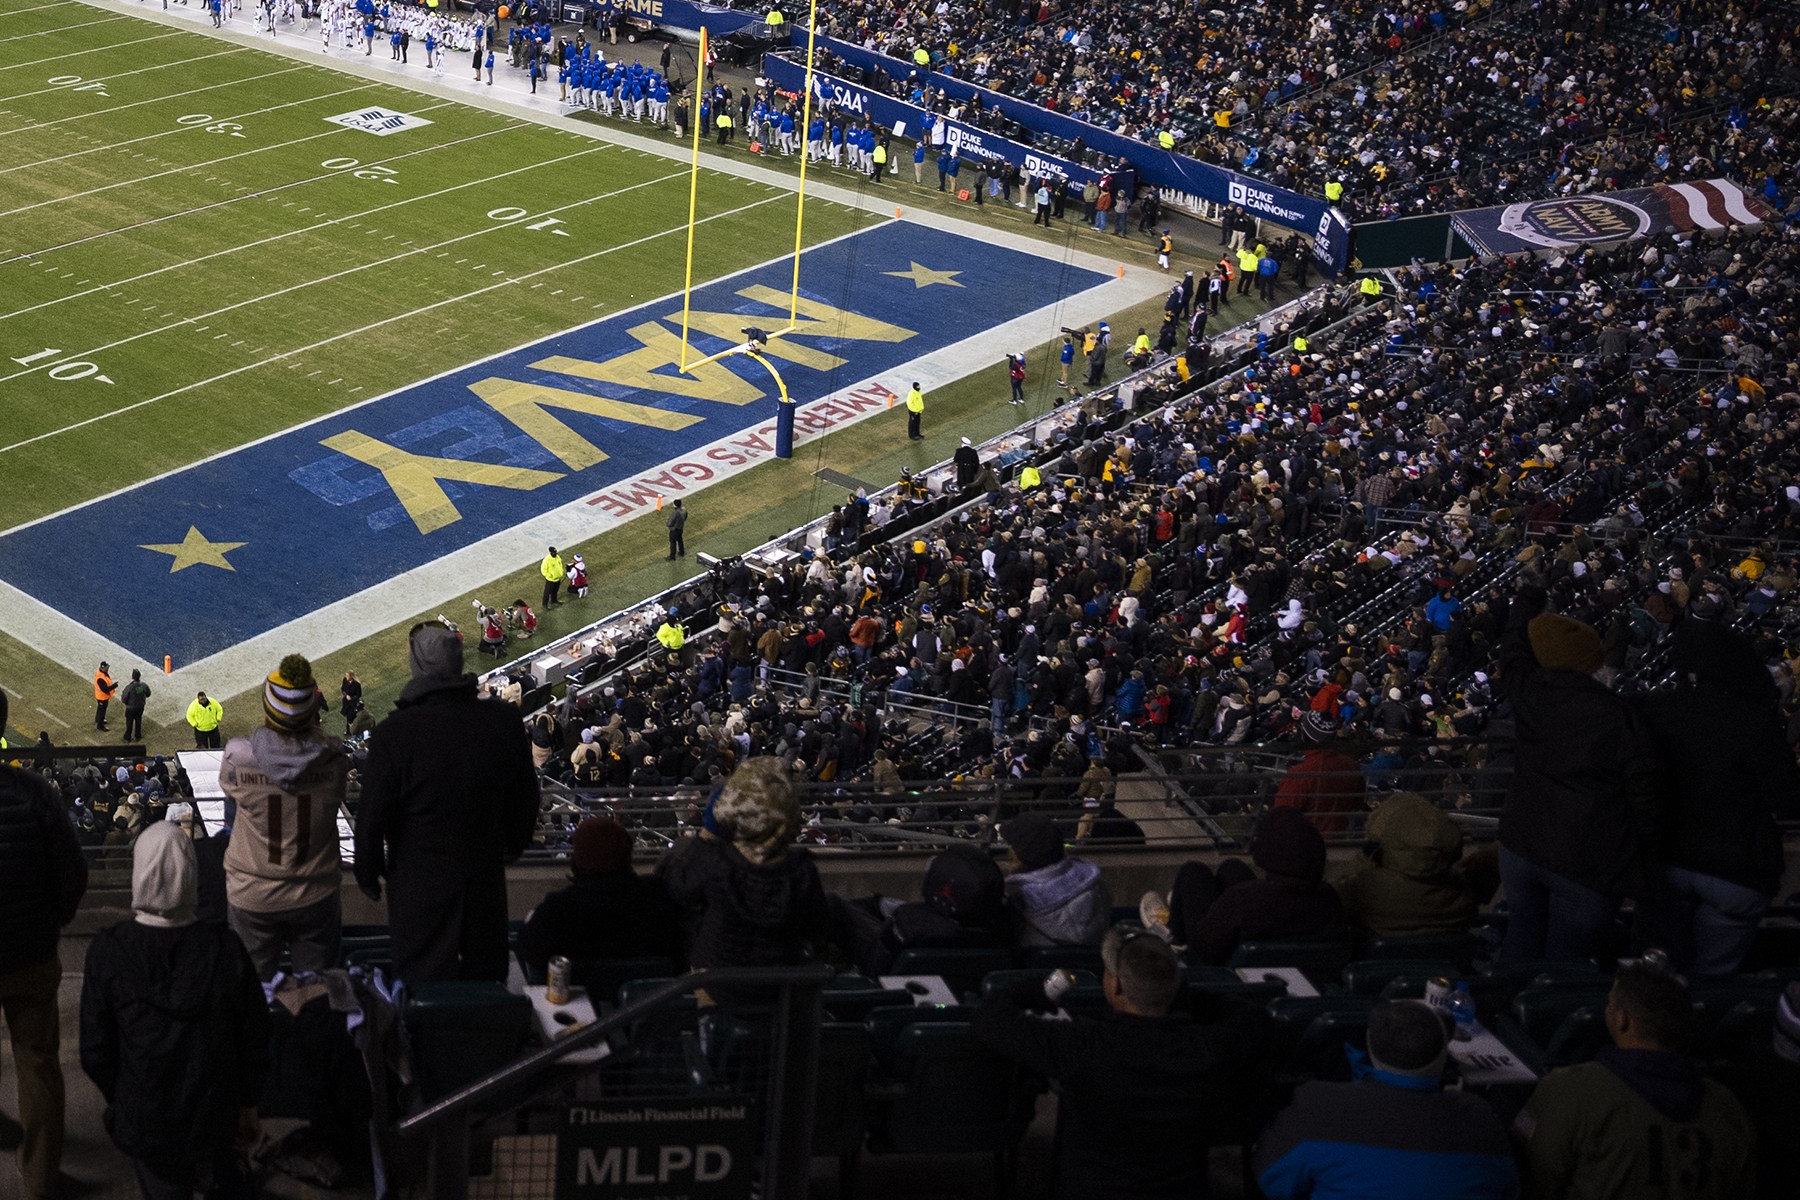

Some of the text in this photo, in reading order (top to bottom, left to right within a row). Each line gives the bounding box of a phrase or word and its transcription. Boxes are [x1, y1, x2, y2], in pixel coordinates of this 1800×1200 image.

[48, 75, 102, 93] 40
[831, 85, 862, 114] SAA
[177, 113, 240, 136] 30
[960, 141, 992, 158] CANNON
[961, 132, 982, 146] DUKE
[320, 156, 398, 182] 20
[1040, 160, 1063, 174] DUKE
[1246, 198, 1288, 219] CANNON
[1248, 188, 1274, 204] DUKE
[487, 206, 564, 233] 10
[1532, 208, 1586, 236] NAVY
[1574, 203, 1632, 232] ARMY
[12, 348, 100, 381] 10
[318, 284, 920, 535] NAVY
[586, 462, 714, 518] GAME
[590, 770, 600, 782] 12
[268, 794, 312, 866] 11
[589, 1106, 746, 1123] Lincoln Financial Field
[576, 1144, 732, 1186] MLPD
[1648, 1124, 1714, 1190] 13
